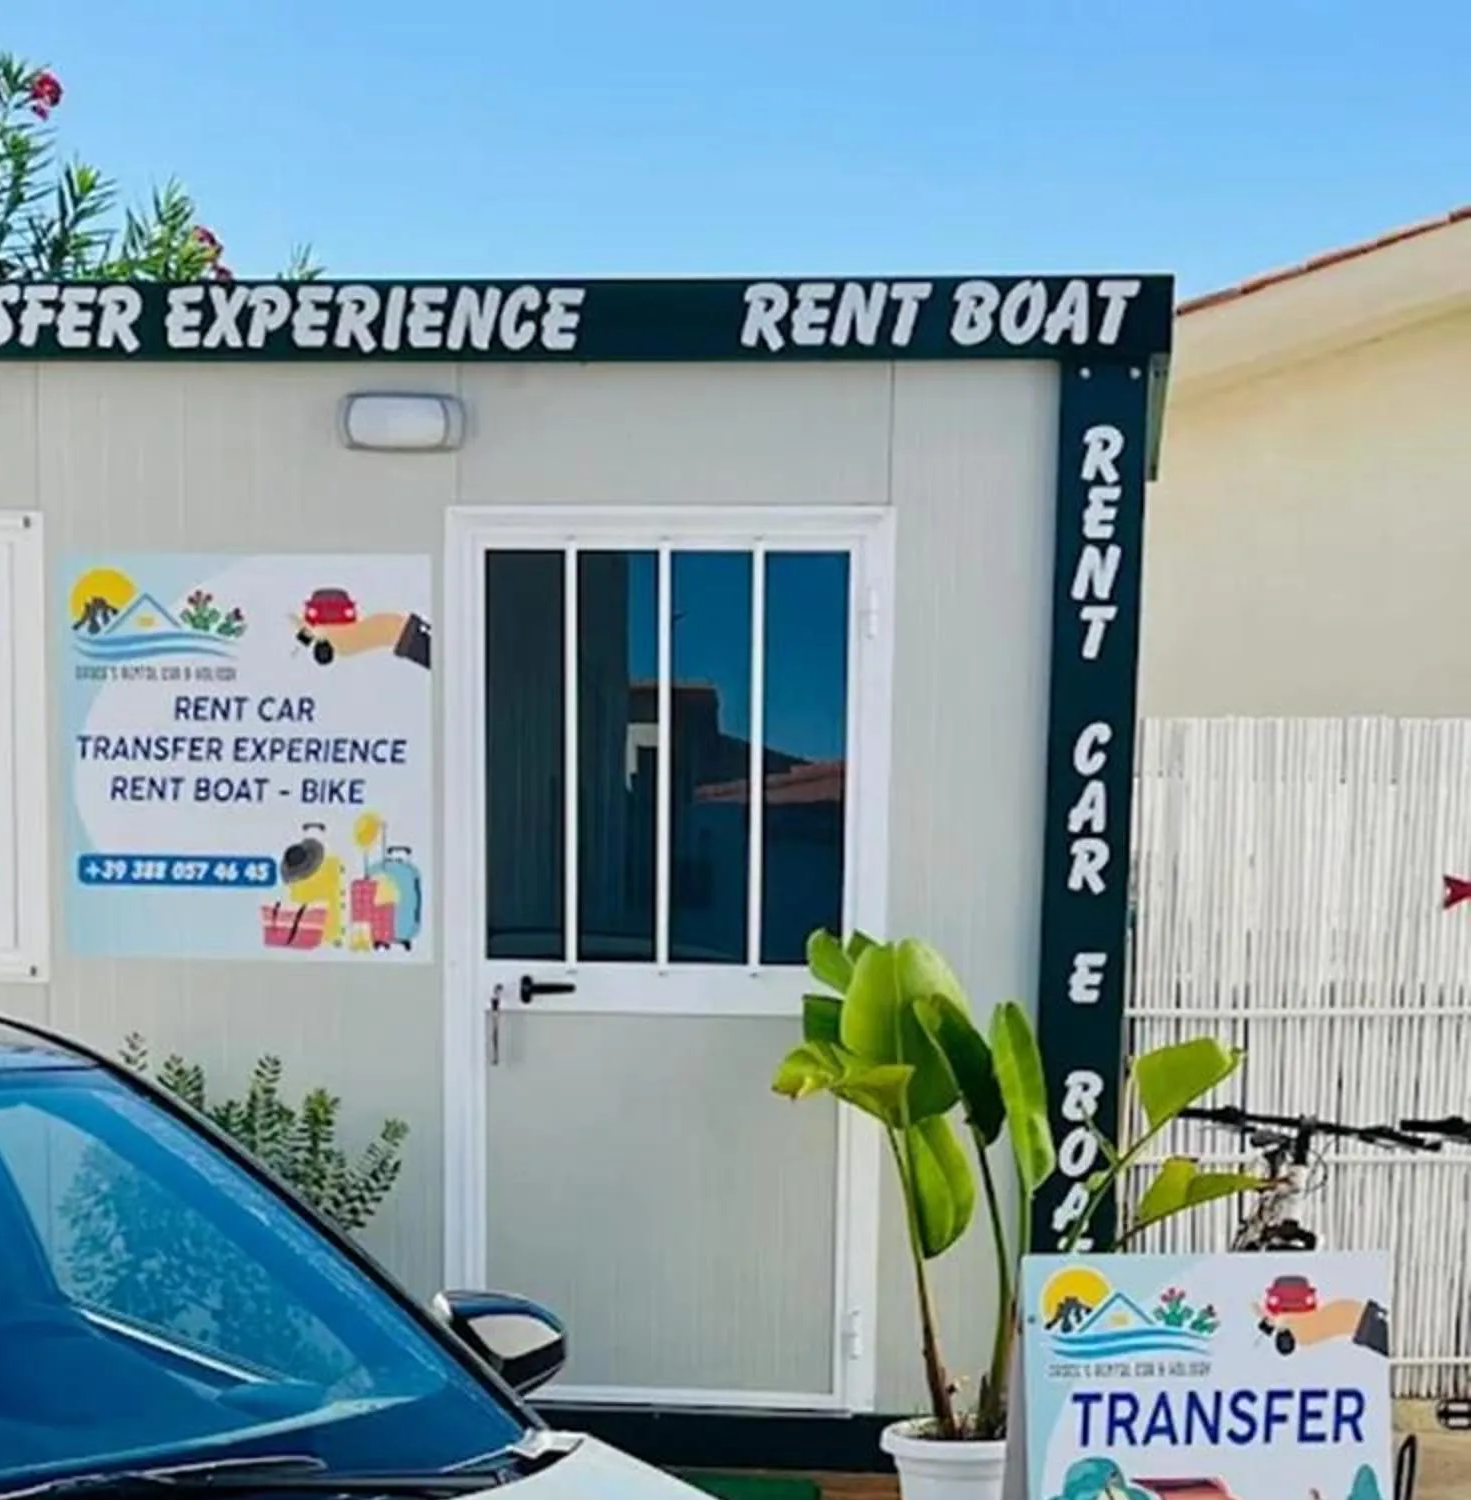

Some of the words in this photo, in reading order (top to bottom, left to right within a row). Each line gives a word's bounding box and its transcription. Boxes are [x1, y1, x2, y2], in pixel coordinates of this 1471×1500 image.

[164, 285, 585, 353] EXPERIENCE
[740, 282, 933, 351] RENT
[950, 279, 1140, 346] BOAT
[1070, 425, 1124, 660] RENT
[174, 696, 249, 722] RENT
[257, 696, 315, 723] CAR
[77, 735, 224, 762] TRANSFER
[232, 736, 408, 764] EXPERIENCE
[110, 775, 185, 802] RENT
[193, 777, 270, 803] BOAT
[301, 778, 365, 805] BIKE
[1067, 721, 1112, 894] CAR
[85, 859, 127, 880] +39
[1068, 952, 1107, 1003] E
[1071, 1388, 1366, 1448] TRANSFER
